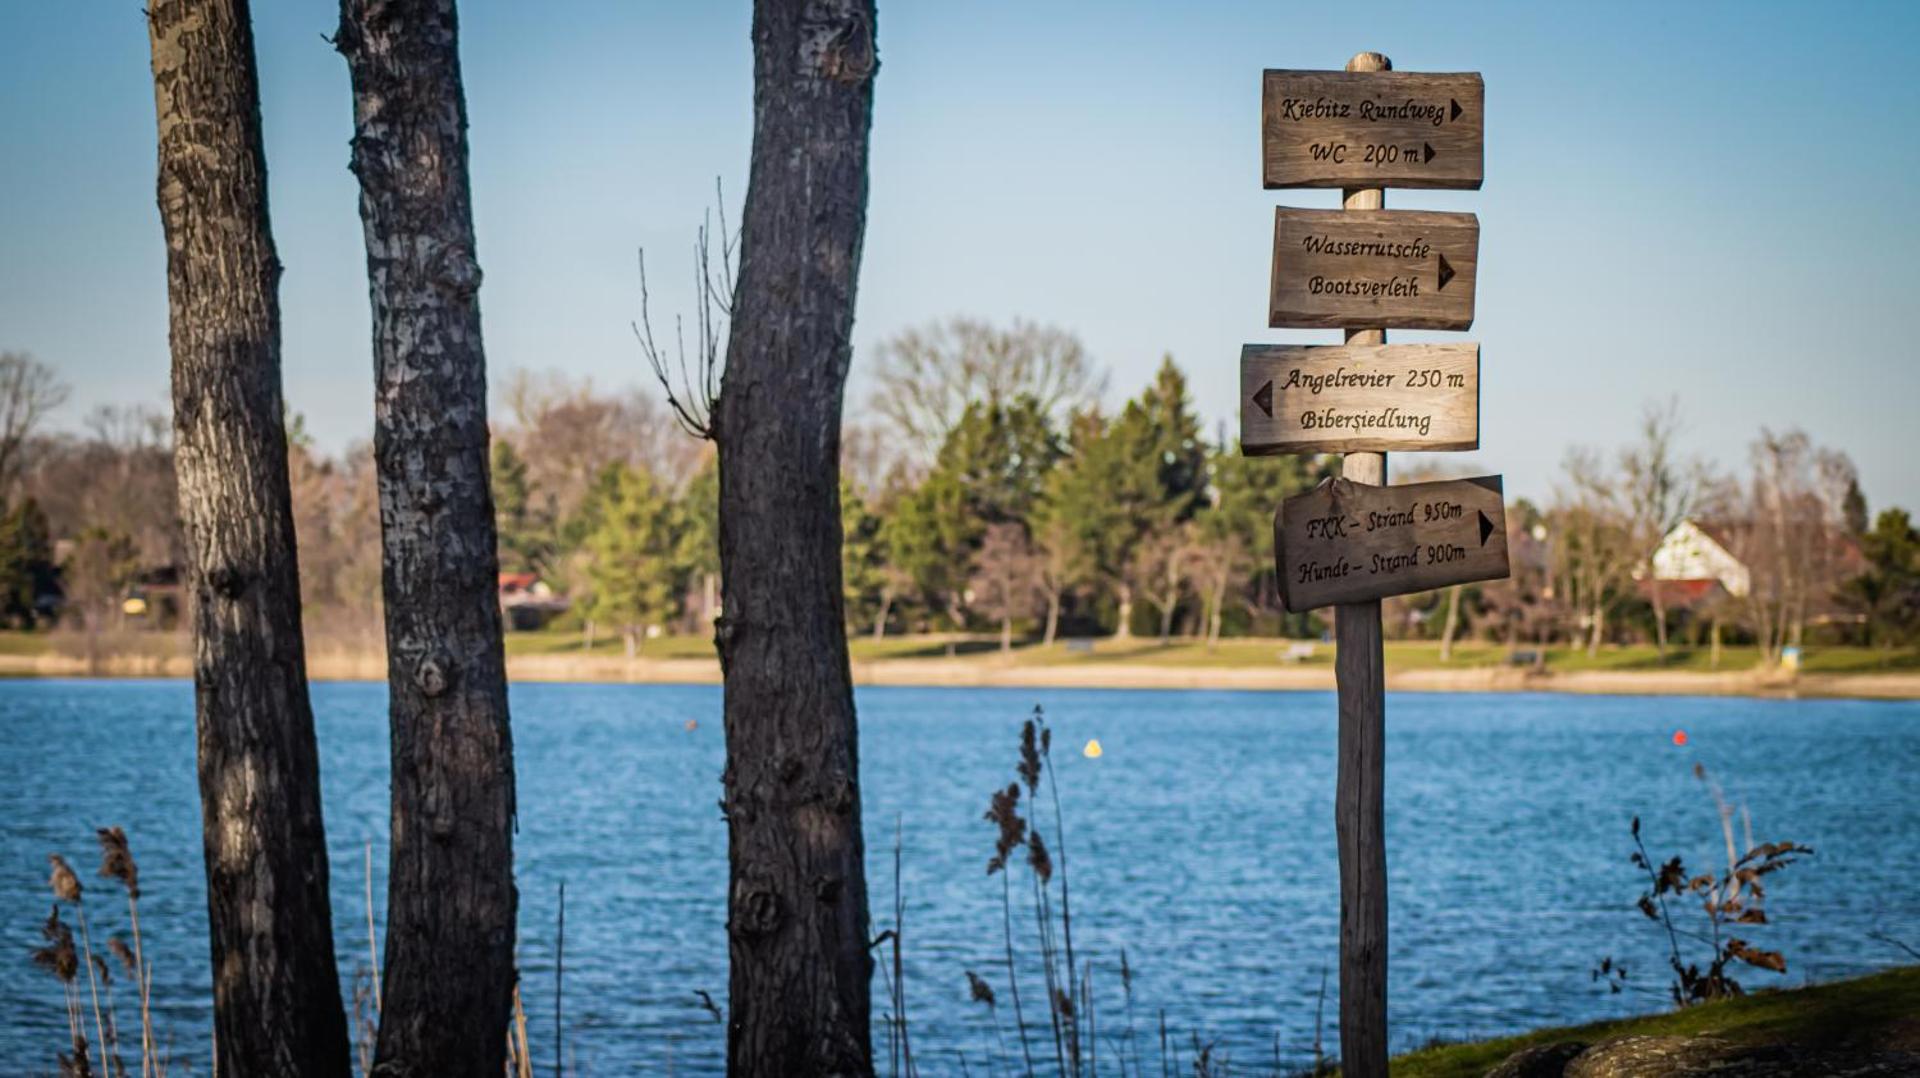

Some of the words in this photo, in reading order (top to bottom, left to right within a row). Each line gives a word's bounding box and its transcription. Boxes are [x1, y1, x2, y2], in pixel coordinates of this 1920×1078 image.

[1281, 97, 1351, 122] Kiebitz
[1359, 98, 1445, 127] Rundweg
[1309, 142, 1347, 164] WC
[1363, 144, 1398, 163] 200
[1403, 147, 1419, 162] m
[1302, 235, 1431, 259] Wasserrutsche
[1308, 275, 1420, 297] Bootsverleih
[1281, 367, 1396, 394] Angelrevier
[1405, 369, 1442, 388] 250
[1446, 372, 1465, 387] m
[1300, 407, 1432, 436] Bibersiedlung
[1367, 503, 1418, 532] Strand
[1370, 545, 1421, 574] Strand
